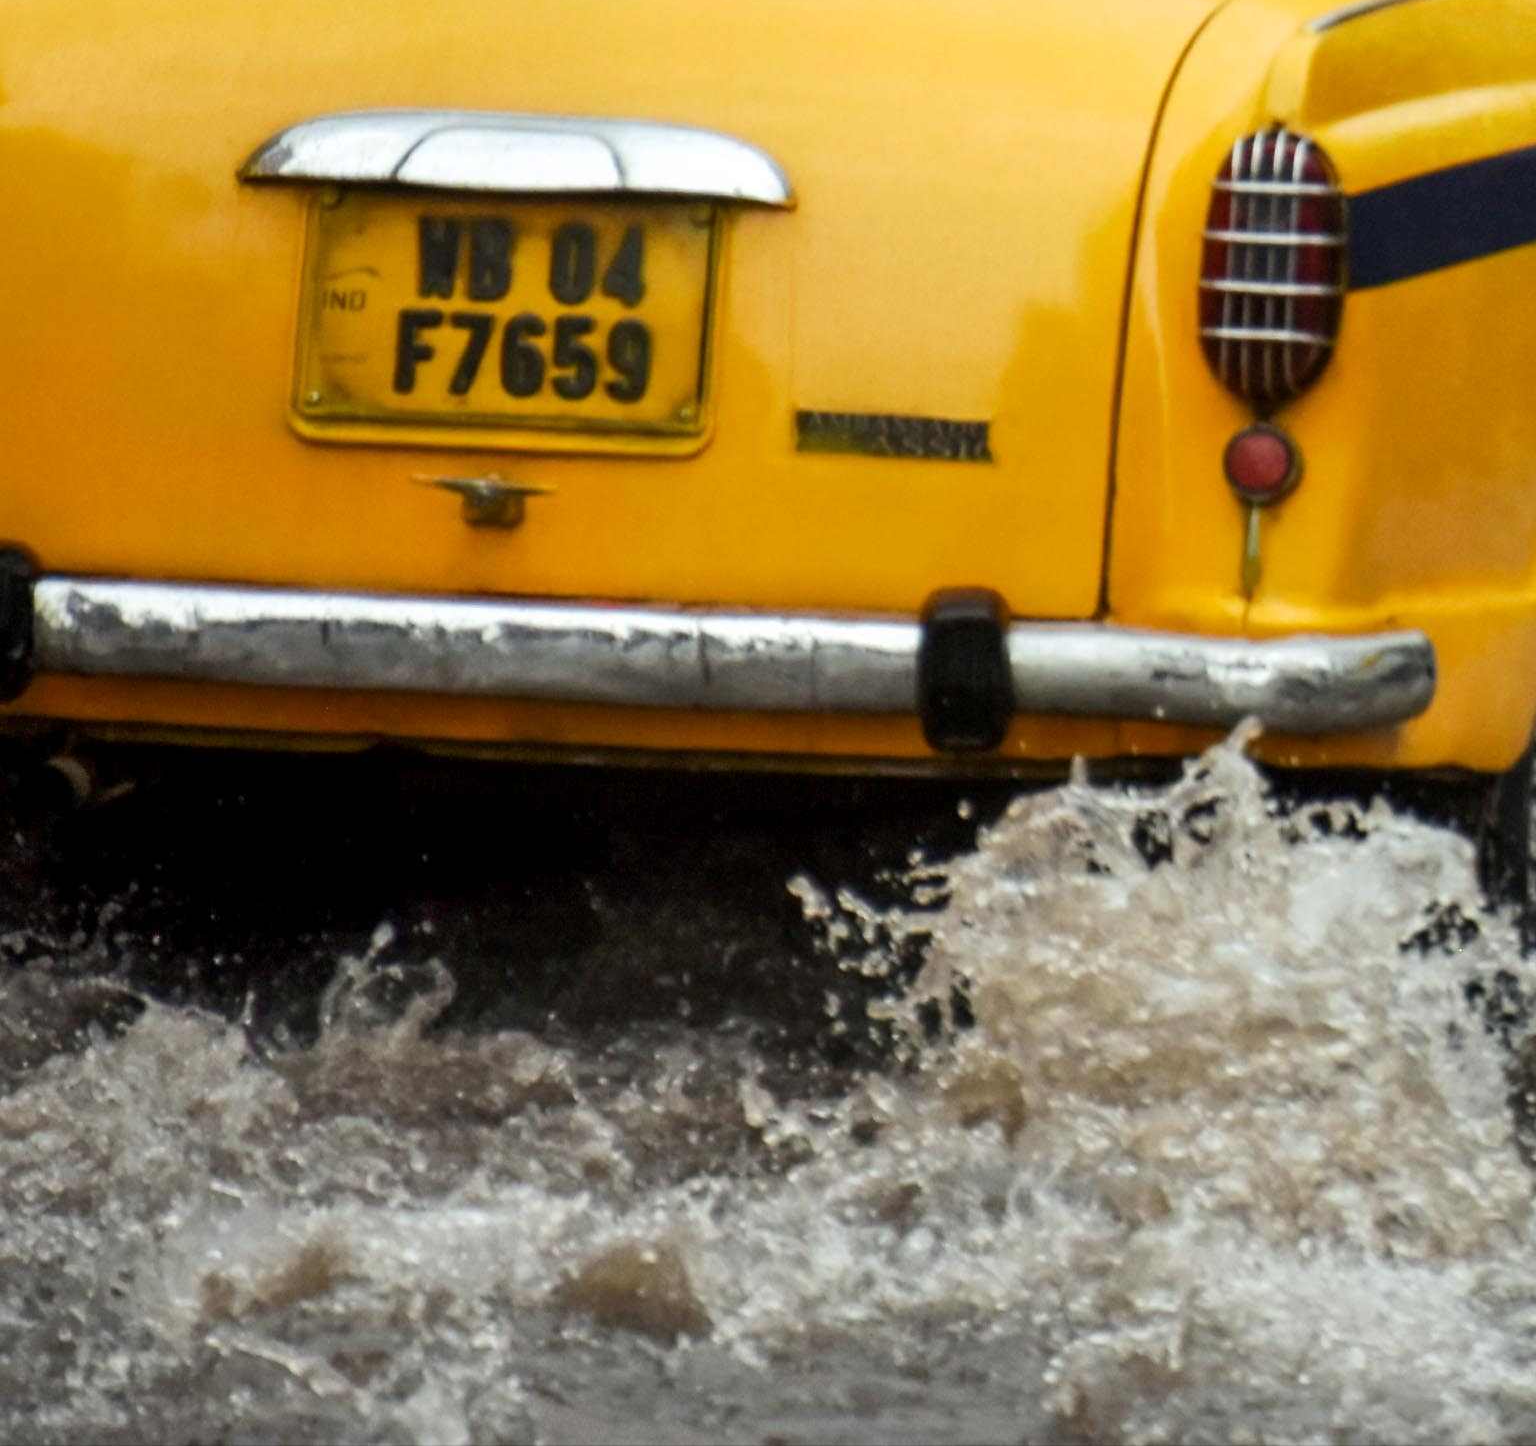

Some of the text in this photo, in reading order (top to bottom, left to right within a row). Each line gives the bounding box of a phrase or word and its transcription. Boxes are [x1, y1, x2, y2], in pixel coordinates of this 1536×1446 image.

[323, 289, 368, 312] IND
[418, 216, 647, 308] WB 04
[393, 308, 652, 404] F7659
